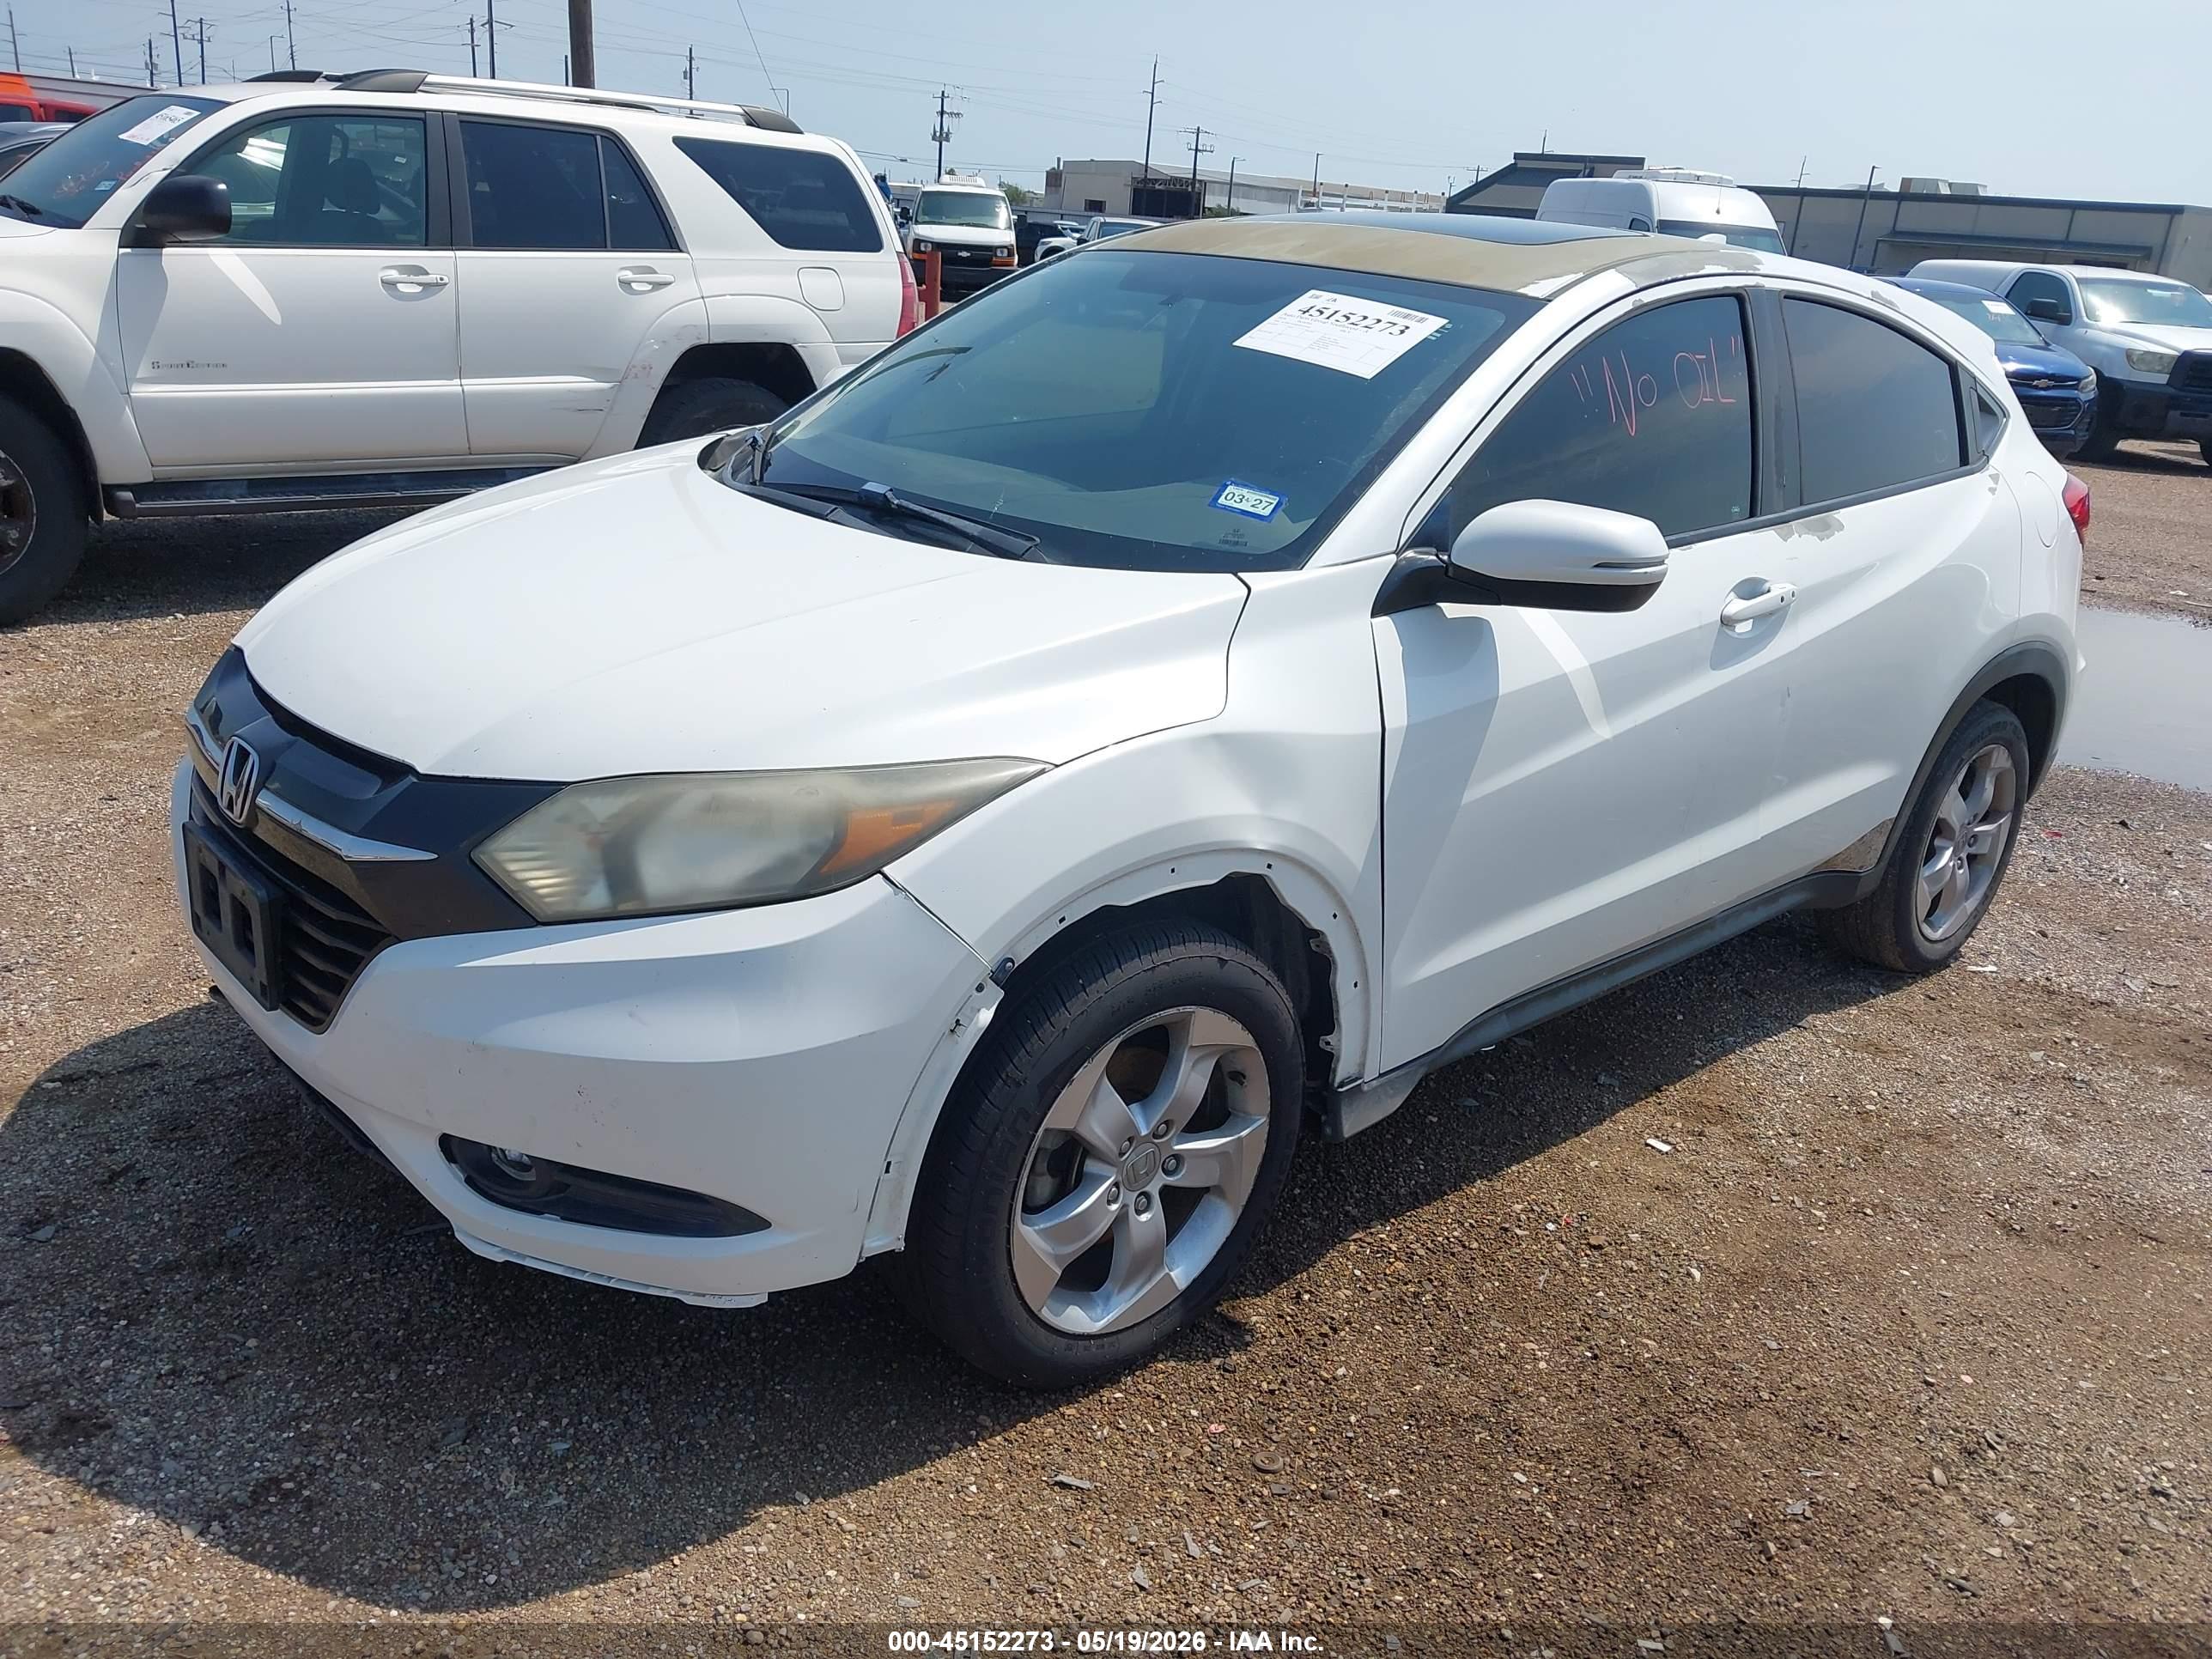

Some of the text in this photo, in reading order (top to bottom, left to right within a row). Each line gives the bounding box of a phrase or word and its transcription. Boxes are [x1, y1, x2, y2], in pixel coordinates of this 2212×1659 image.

[1297, 305, 1410, 336] 45152273
[1224, 491, 1274, 511] 03 27
